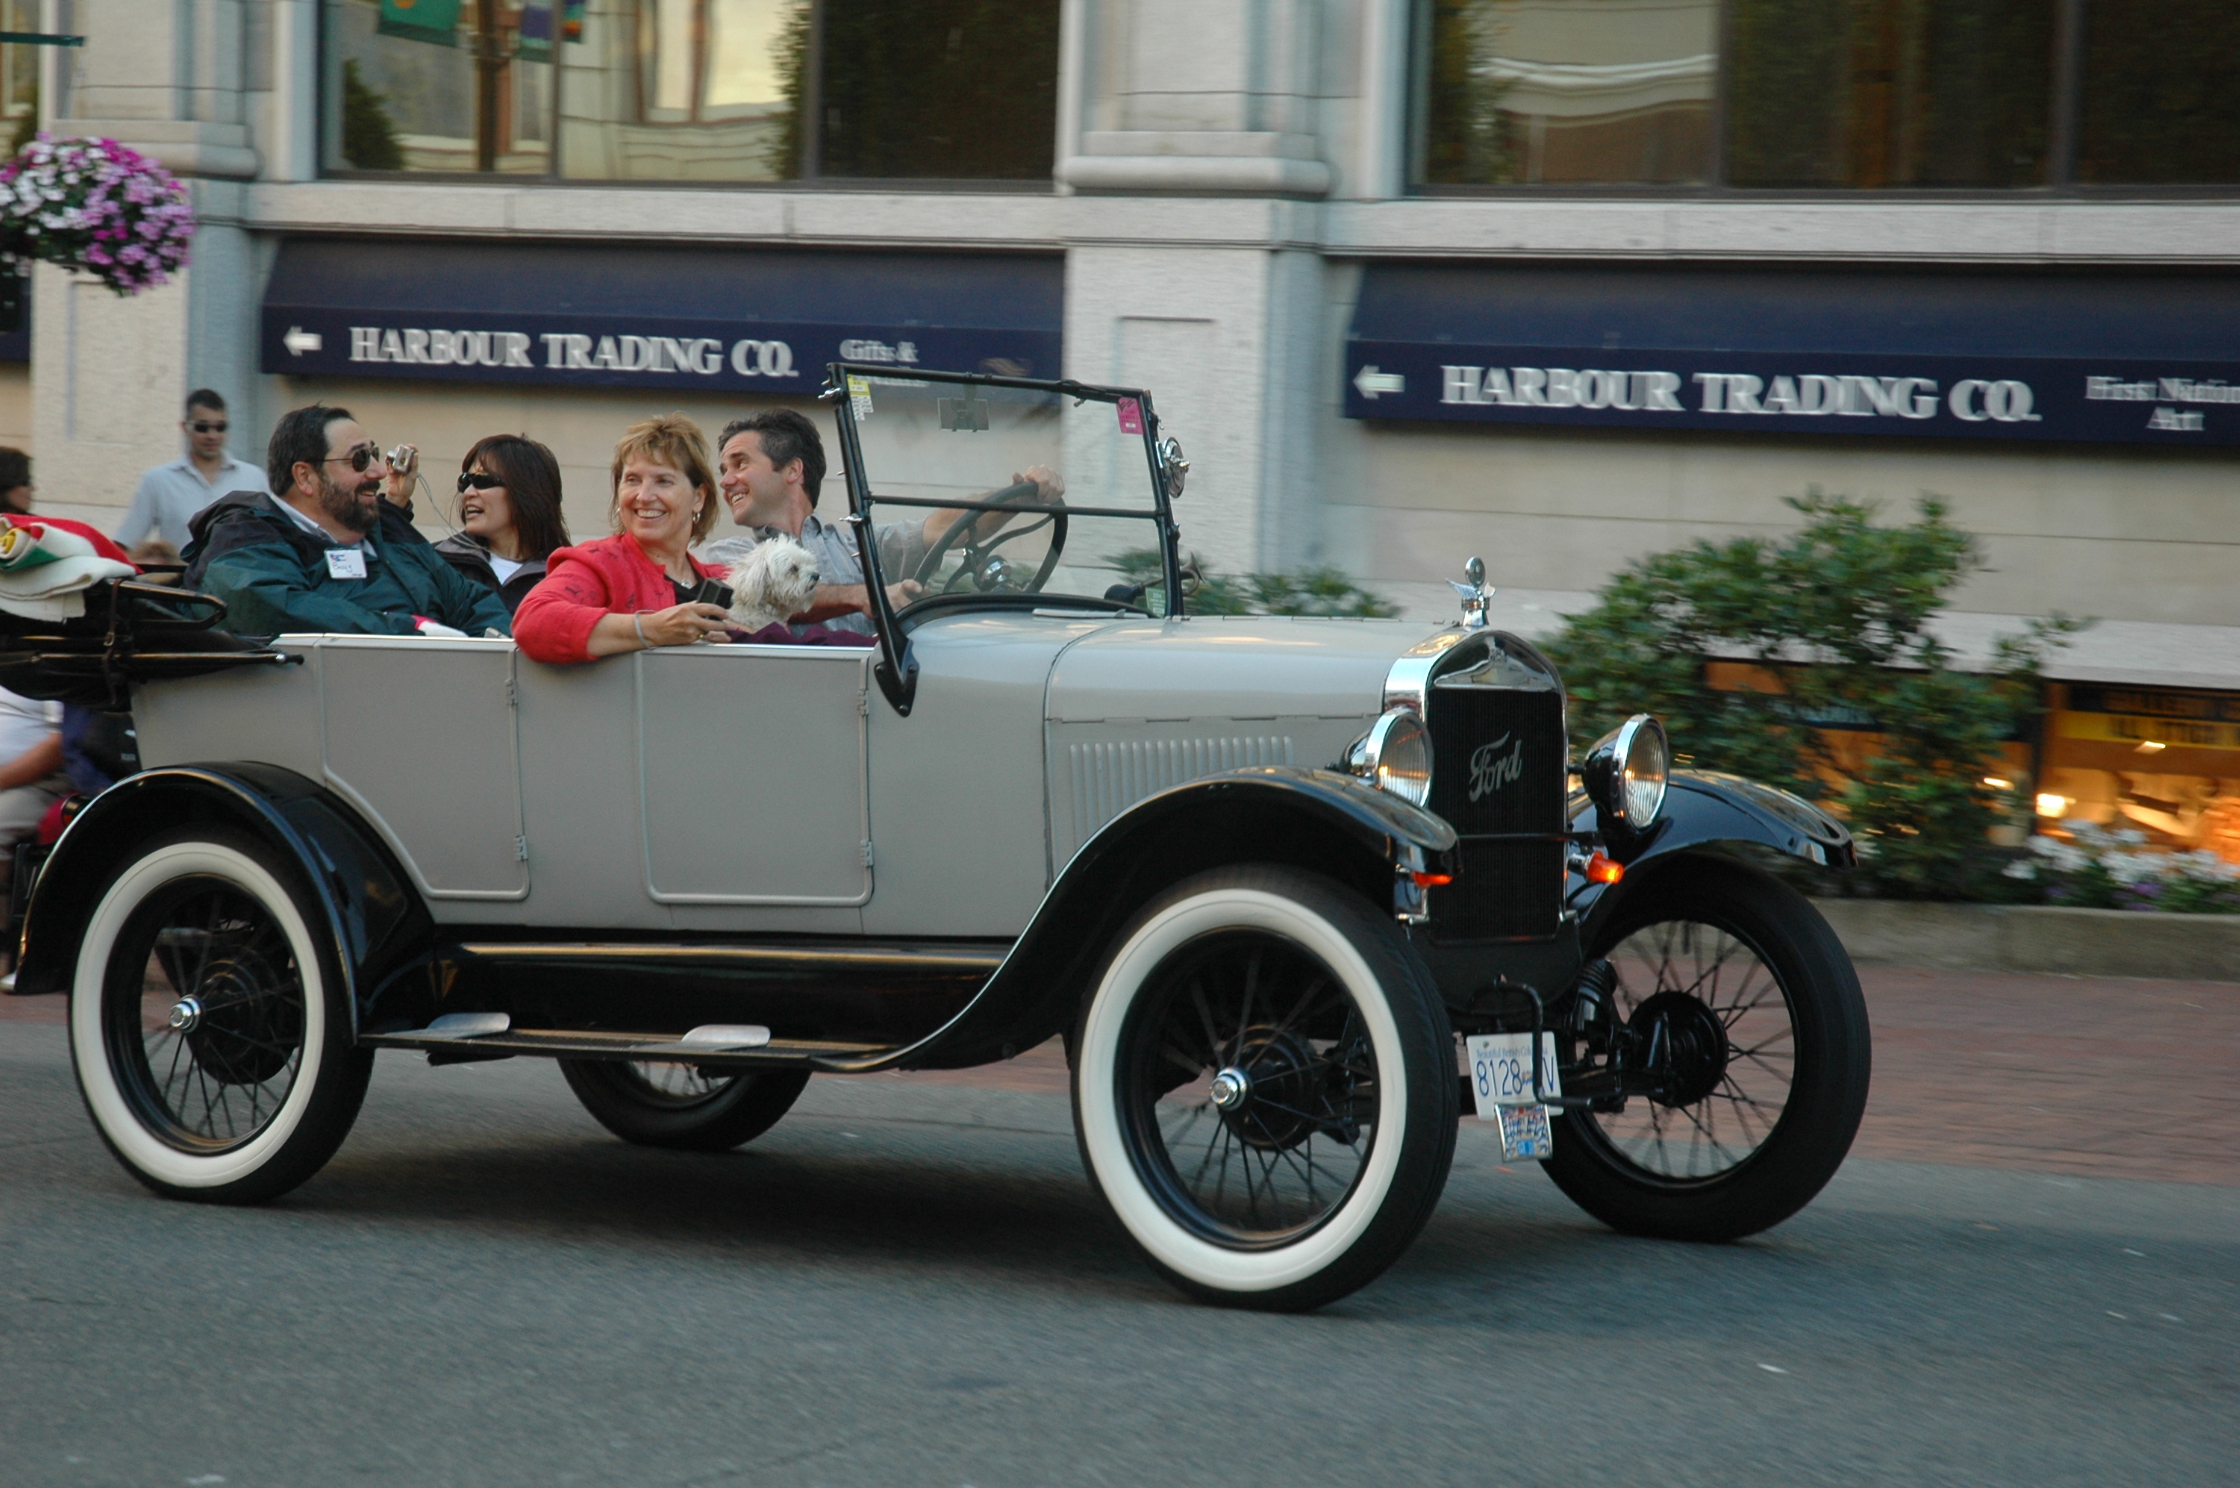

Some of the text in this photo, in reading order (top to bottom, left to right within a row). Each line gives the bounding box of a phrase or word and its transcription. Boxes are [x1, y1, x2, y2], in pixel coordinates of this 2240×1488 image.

[348, 326, 534, 368] HARBOUR
[539, 333, 724, 375] TRADING
[839, 339, 919, 362] Gifts &
[1440, 365, 1686, 411] HARBOUR
[1692, 372, 1941, 418] TRADING
[2085, 375, 2157, 401] First
[2146, 406, 2205, 431] Art
[1469, 731, 1522, 802] Ford
[1476, 1058, 1523, 1097] 8128
